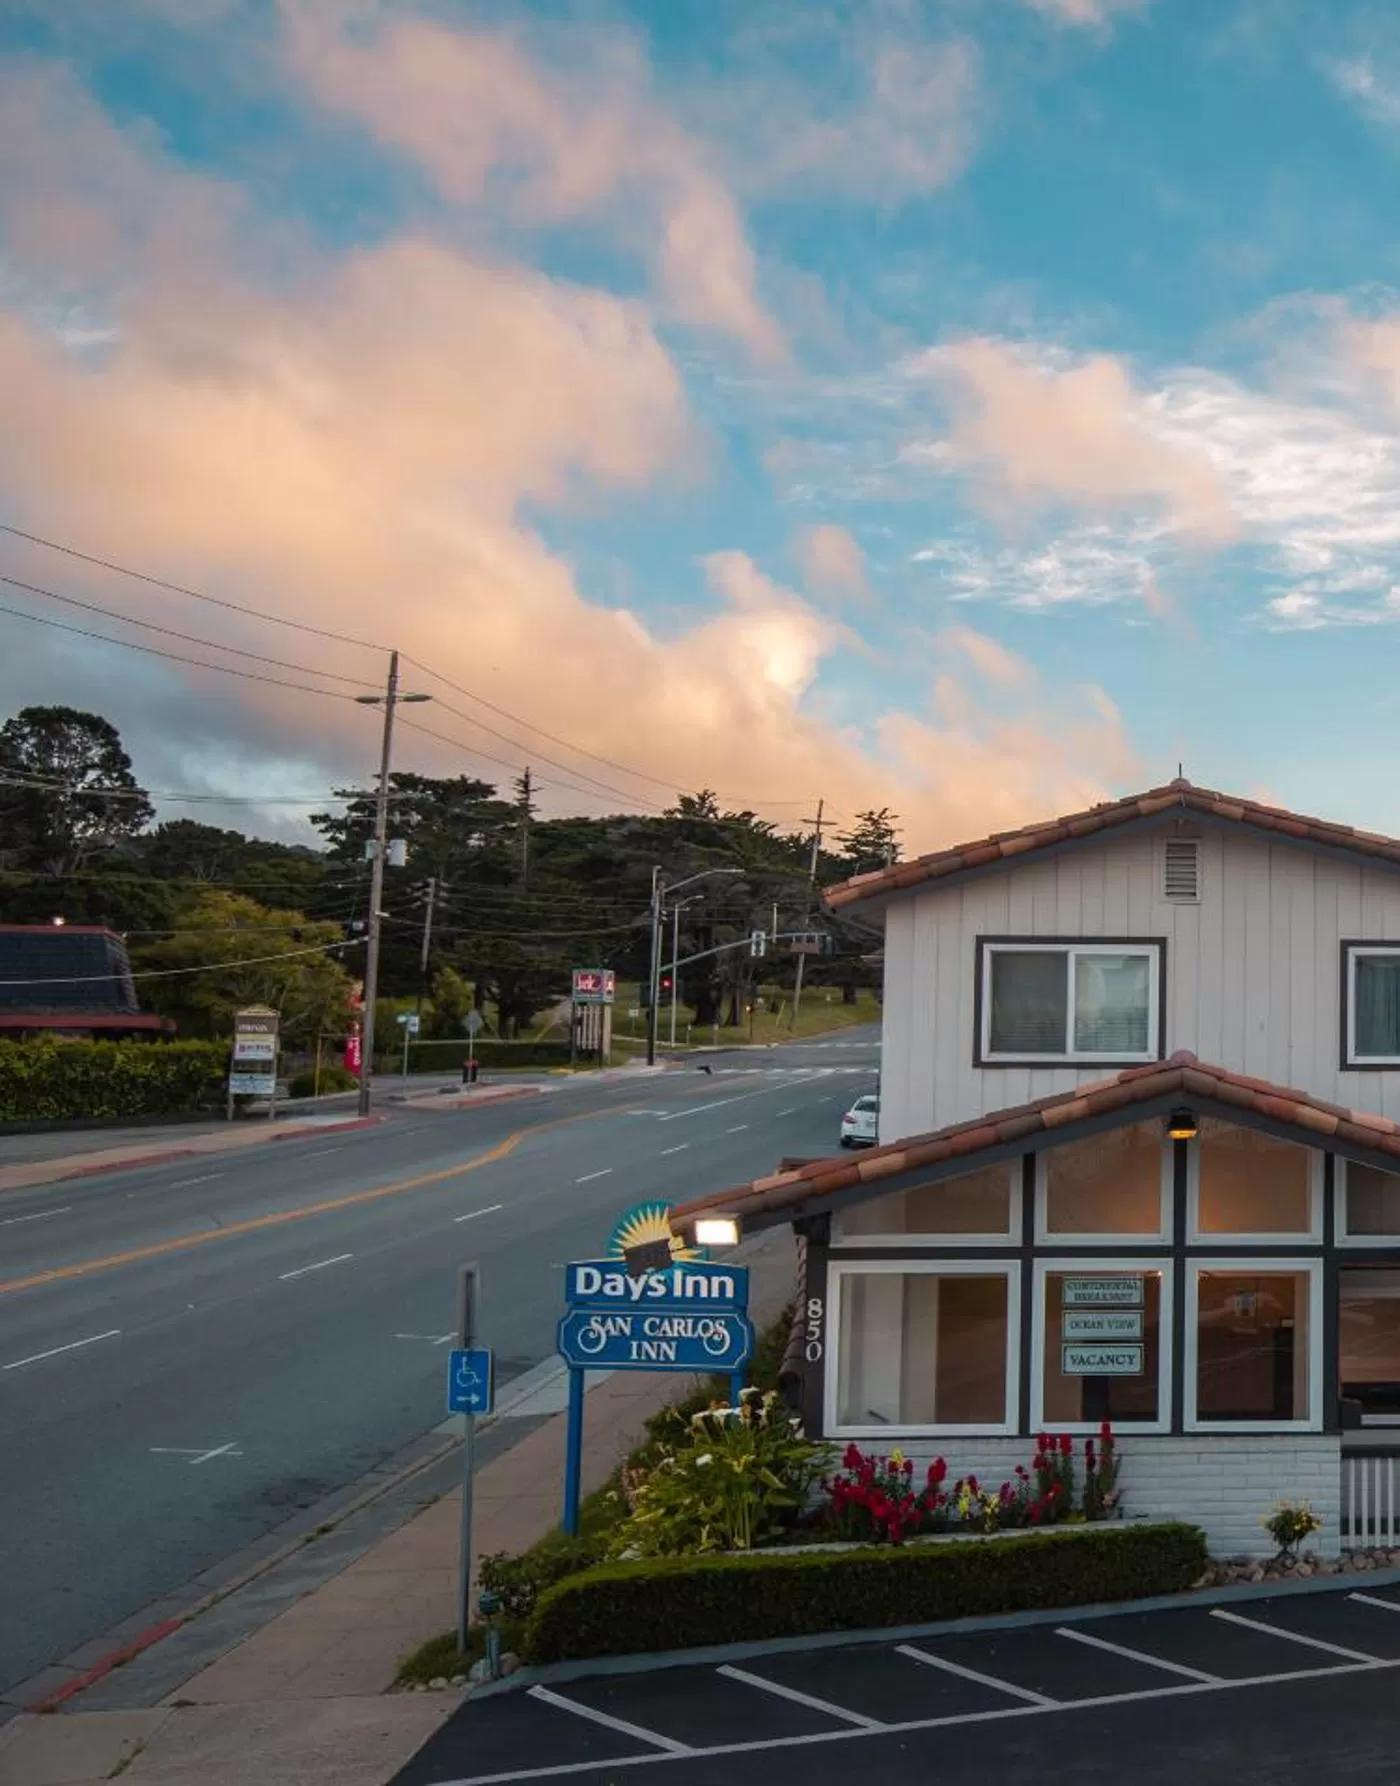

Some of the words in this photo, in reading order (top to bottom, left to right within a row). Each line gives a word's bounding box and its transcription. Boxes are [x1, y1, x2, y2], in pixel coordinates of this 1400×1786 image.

[576, 1267, 666, 1300] Days
[674, 1270, 734, 1298] Inn
[643, 1317, 730, 1355] CARLOS
[806, 1298, 823, 1362] 850
[1070, 1320, 1104, 1330] OCEAN
[1108, 1320, 1135, 1330] VIEW
[630, 1341, 677, 1361] INN
[1070, 1354, 1136, 1365] VACANCY
